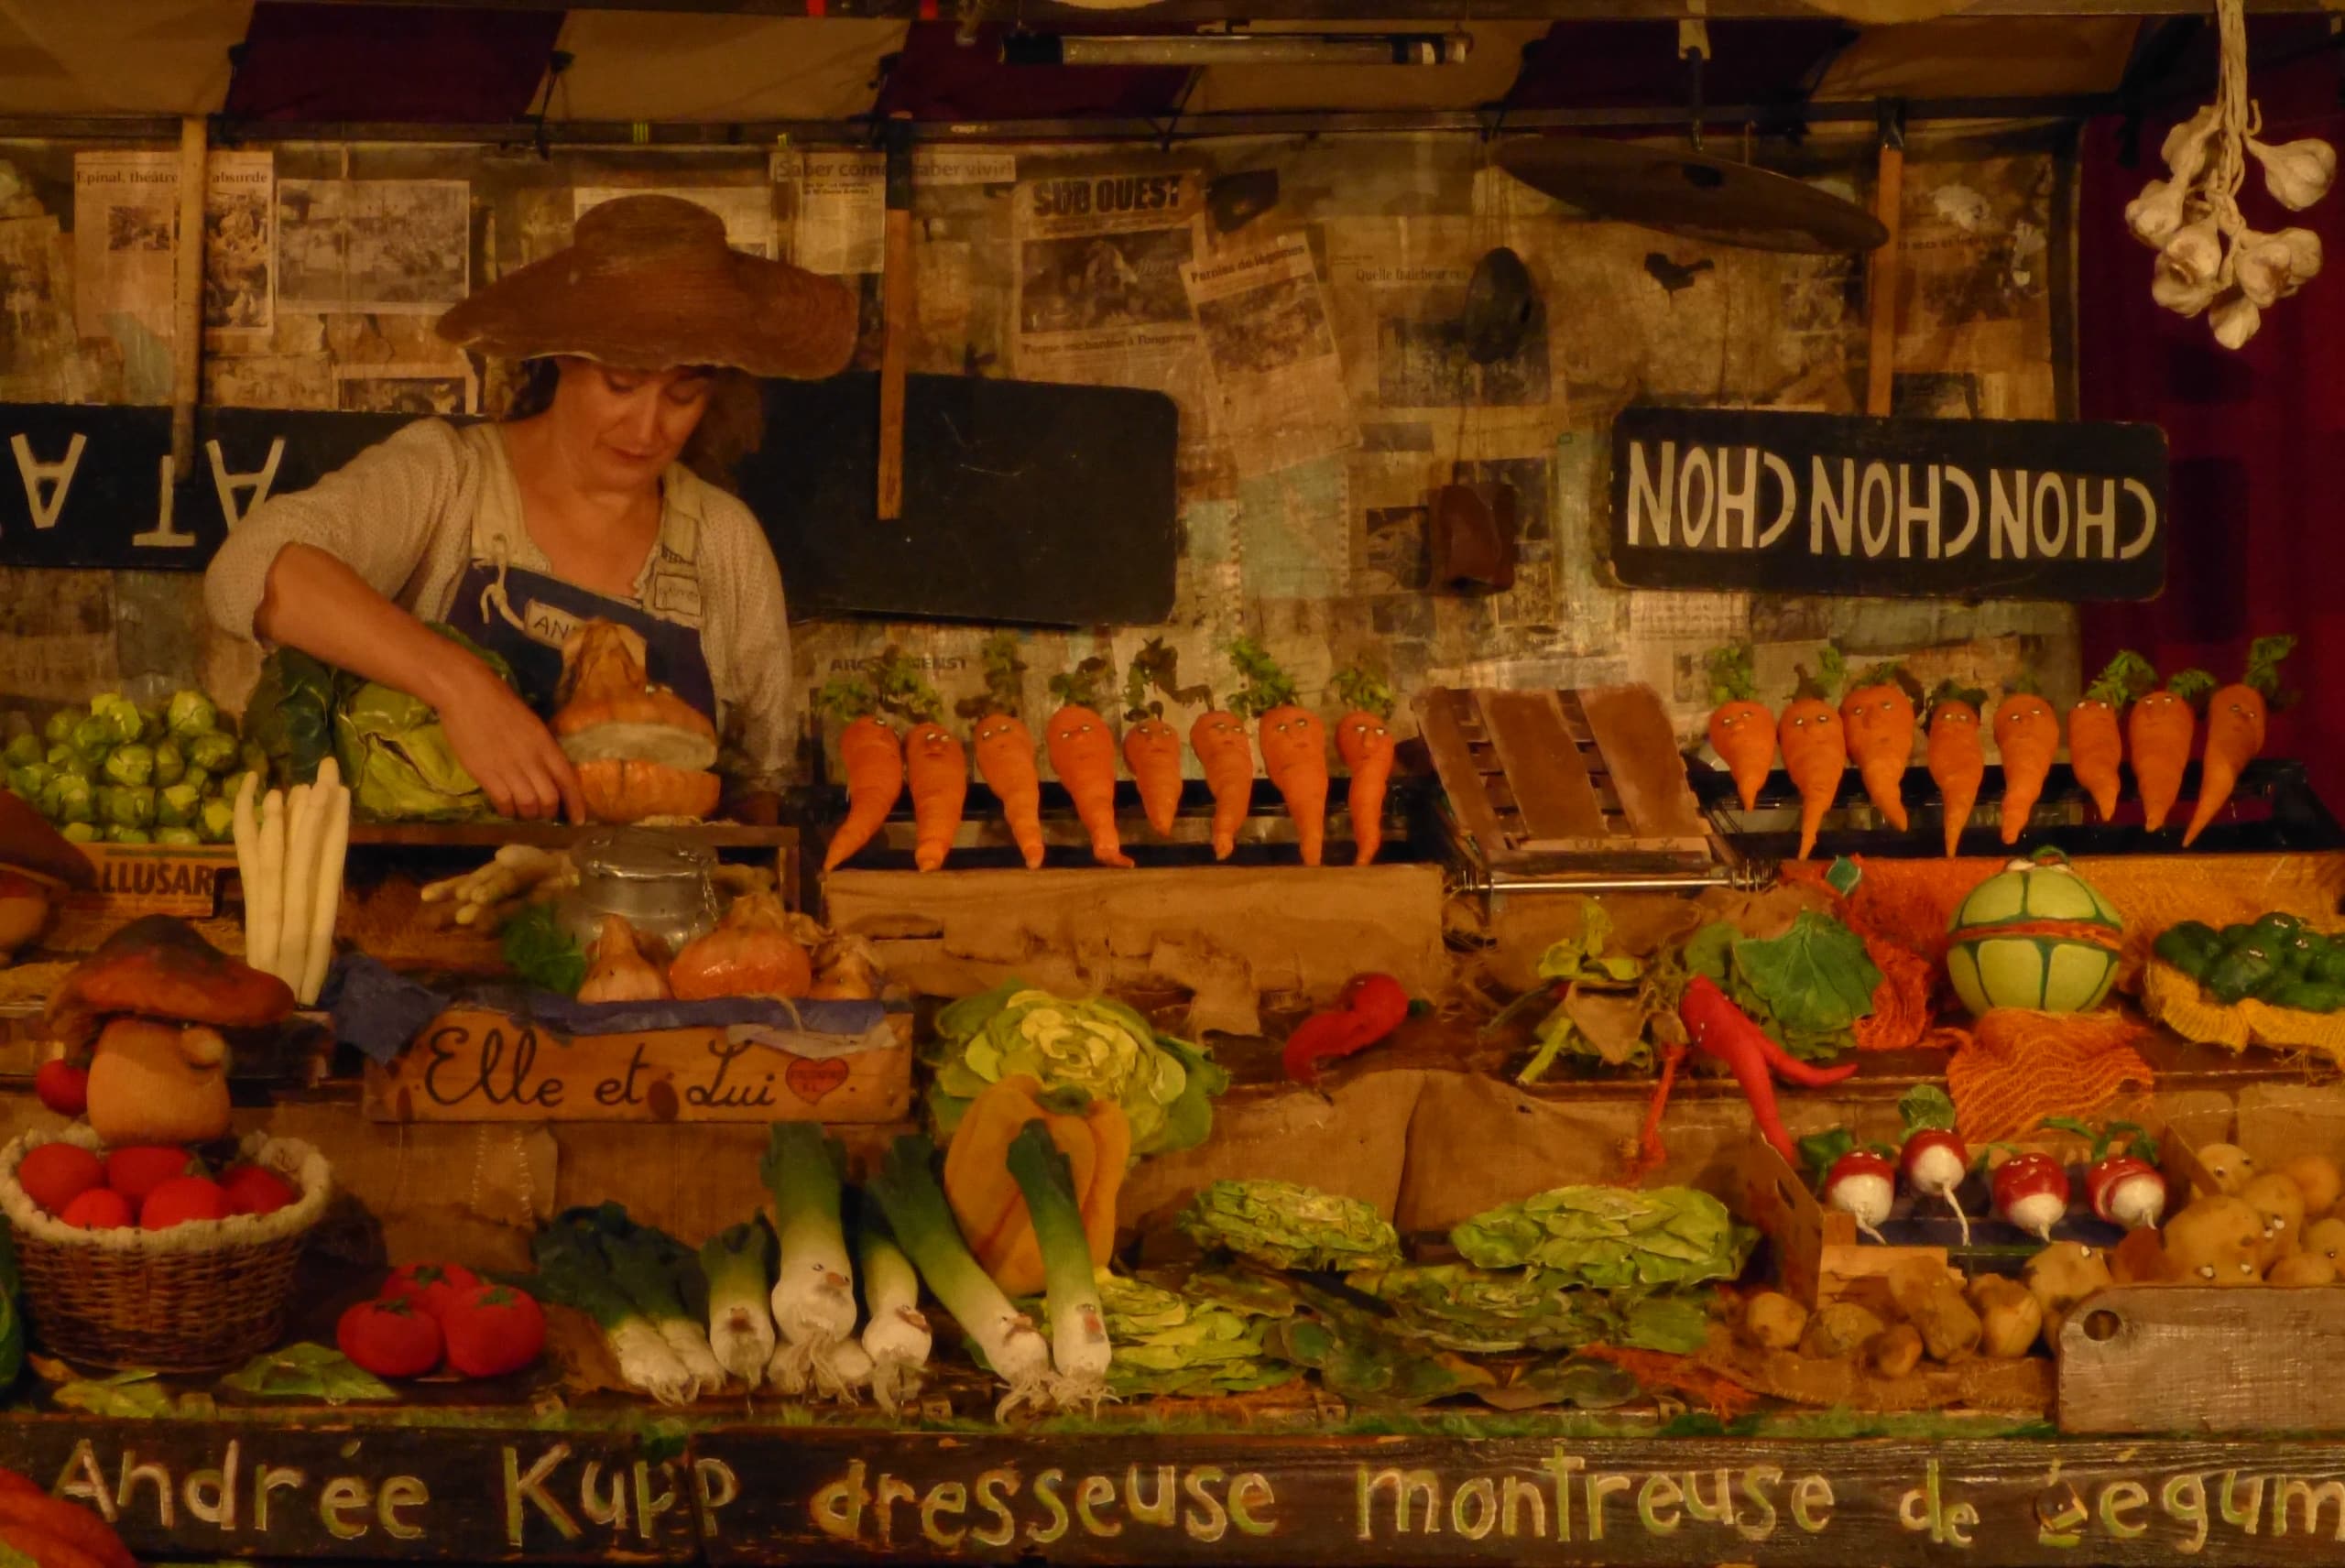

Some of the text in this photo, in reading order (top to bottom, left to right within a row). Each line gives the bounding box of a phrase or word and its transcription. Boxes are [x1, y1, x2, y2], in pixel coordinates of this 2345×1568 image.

[1032, 174, 1183, 217] SUD OUEST
[533, 615, 576, 640] AN
[424, 1026, 564, 1107] Elle
[594, 1043, 651, 1107] et
[686, 1039, 778, 1108] Lui
[55, 1438, 430, 1539] Andrée
[503, 1442, 739, 1548] Kupp
[809, 1458, 1280, 1548] dresseuse
[1357, 1445, 1835, 1542] montreuse
[1899, 1459, 1980, 1549] de
